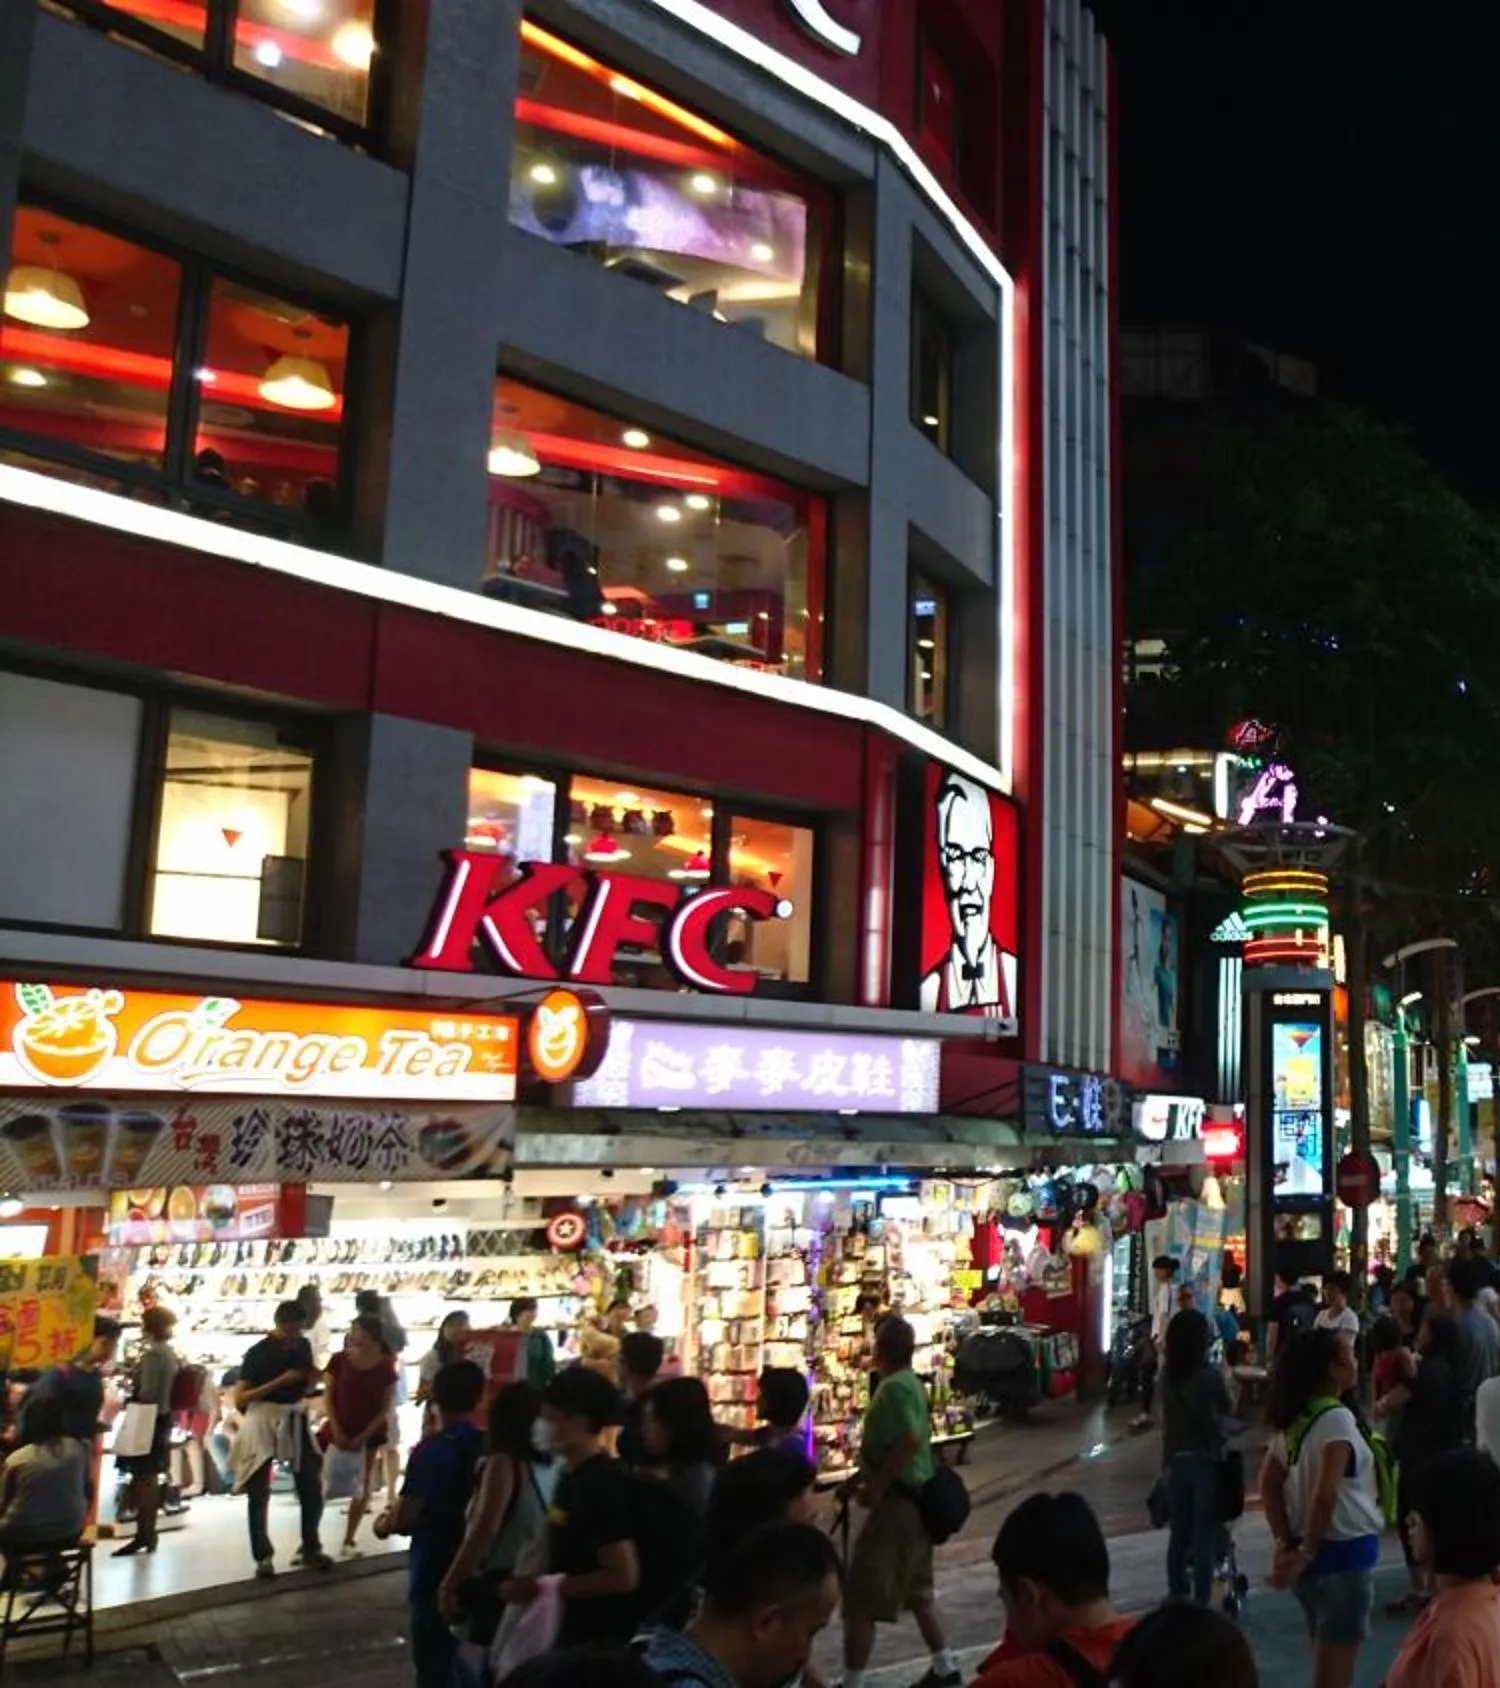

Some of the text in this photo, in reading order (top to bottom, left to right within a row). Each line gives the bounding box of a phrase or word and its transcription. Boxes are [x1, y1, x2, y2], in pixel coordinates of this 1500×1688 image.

[412, 848, 780, 994] KFC
[131, 1010, 470, 1088] Orange Tea
[230, 1107, 411, 1175] 珍珠奶茶
